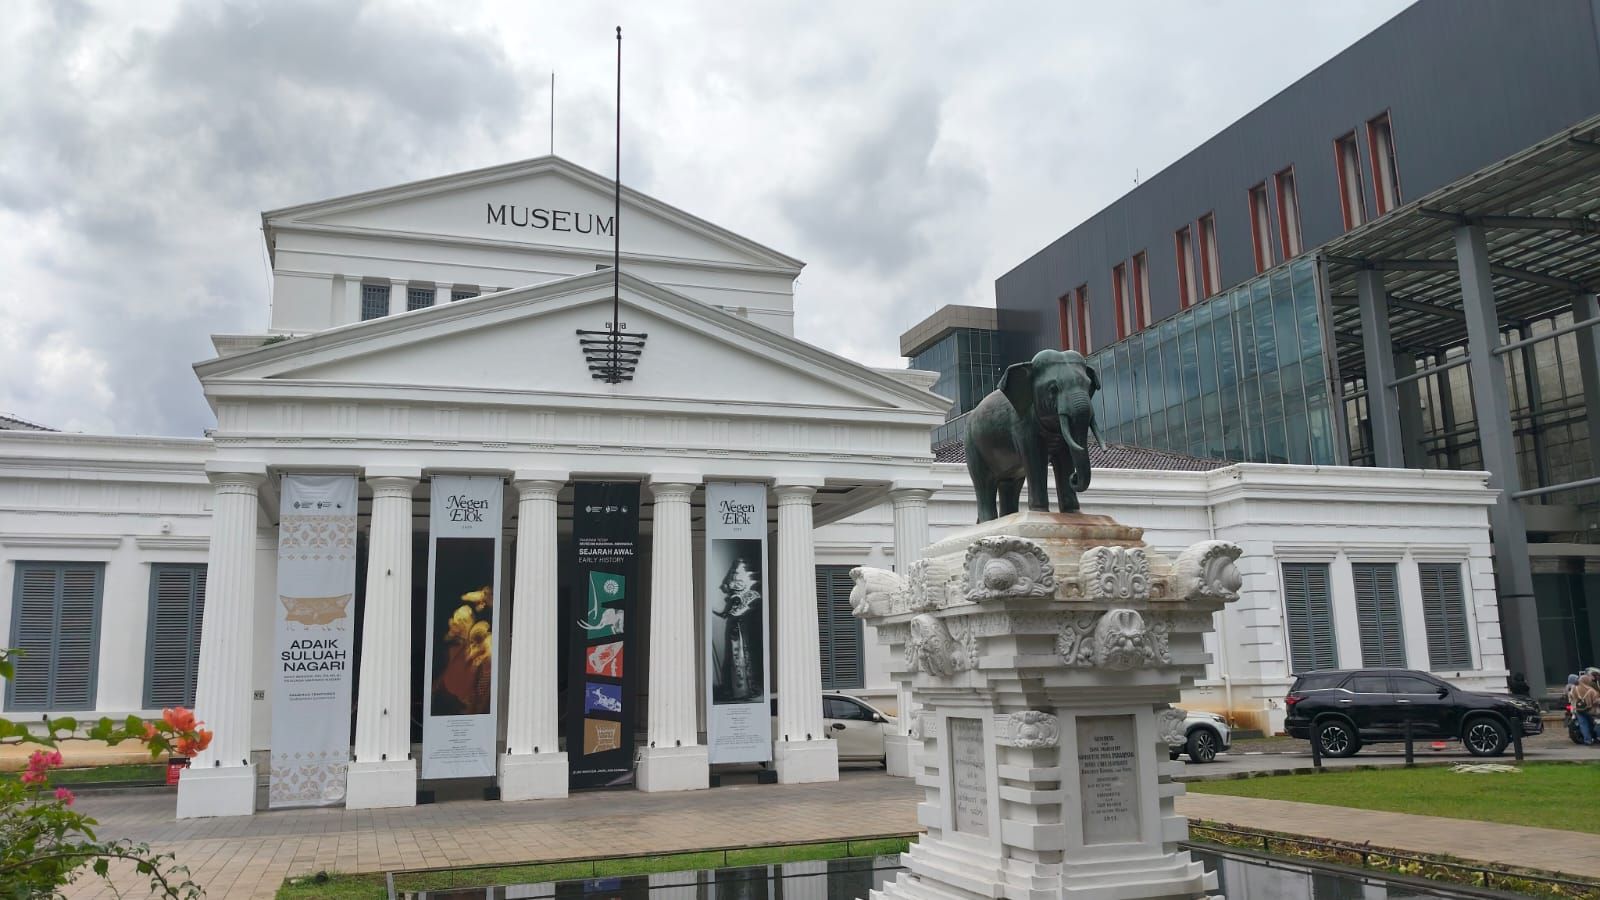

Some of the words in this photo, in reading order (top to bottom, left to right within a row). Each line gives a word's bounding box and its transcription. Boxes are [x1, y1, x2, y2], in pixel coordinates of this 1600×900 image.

[487, 203, 614, 237] MUSEUM
[450, 508, 483, 522] Elok
[722, 512, 752, 525] Elok
[290, 639, 338, 649] ADAIK
[281, 650, 346, 661] SULUAH
[283, 661, 345, 672] NAGARI
